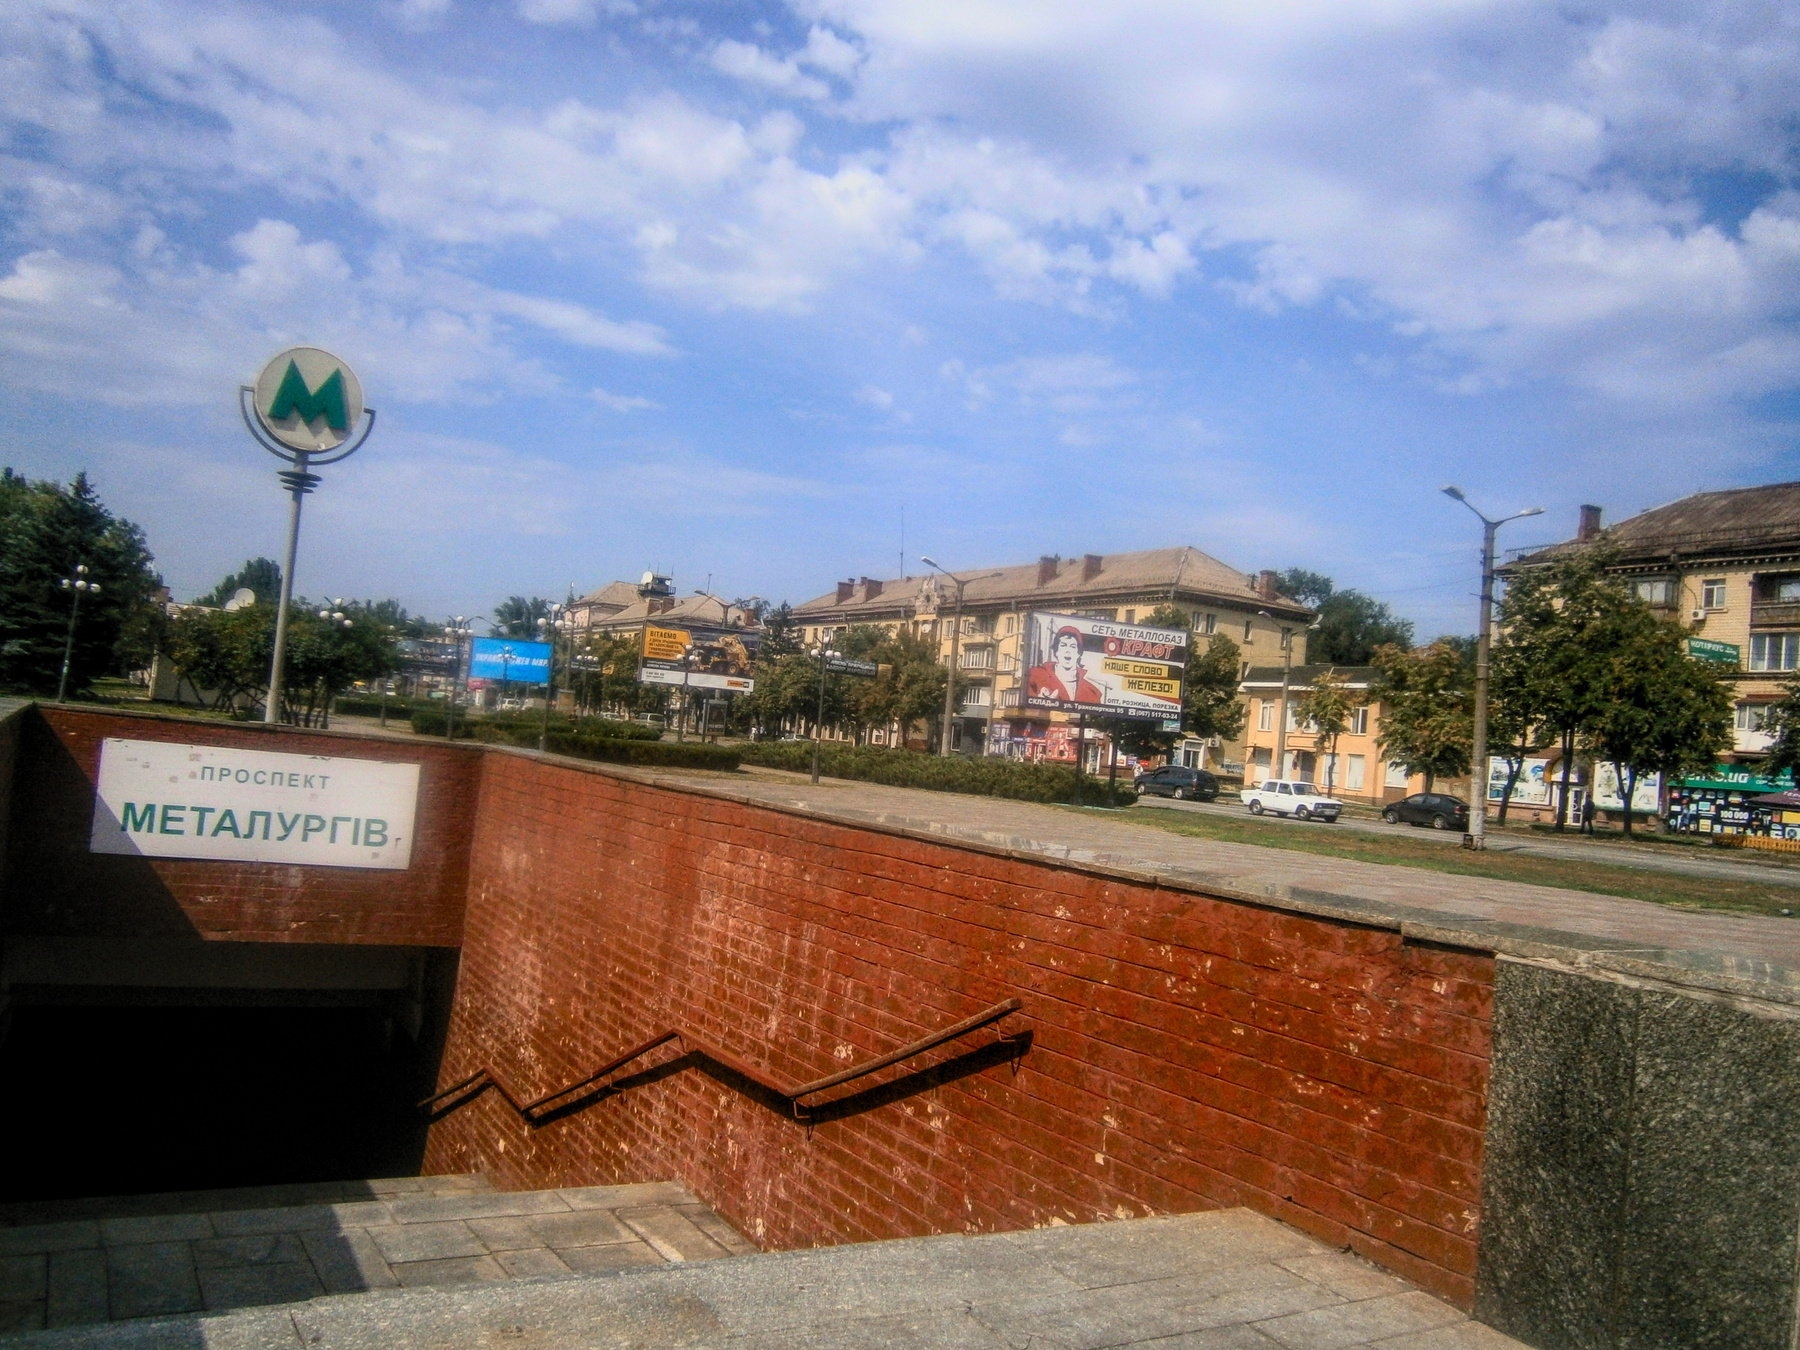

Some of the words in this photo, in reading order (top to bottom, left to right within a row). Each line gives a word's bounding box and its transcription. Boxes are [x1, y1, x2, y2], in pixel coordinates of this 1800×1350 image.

[1091, 624, 1117, 636] СЕТЬ
[1118, 628, 1183, 645] МЕТАЛЛОБАЗ
[1121, 639, 1175, 659] КРАФТ
[1104, 661, 1130, 672] НАШЕ
[1133, 664, 1163, 676] СЛОВО
[1127, 679, 1173, 694] ЖЕЛЕЗО!
[1074, 703, 1116, 713] Транспортная
[1122, 699, 1151, 708] РОЗНИЦА,
[1152, 703, 1179, 711] ПОРЕЗКА
[200, 766, 332, 790] ПРОСПЕКТ
[119, 802, 389, 848] МЕТАЛУРГІВ
